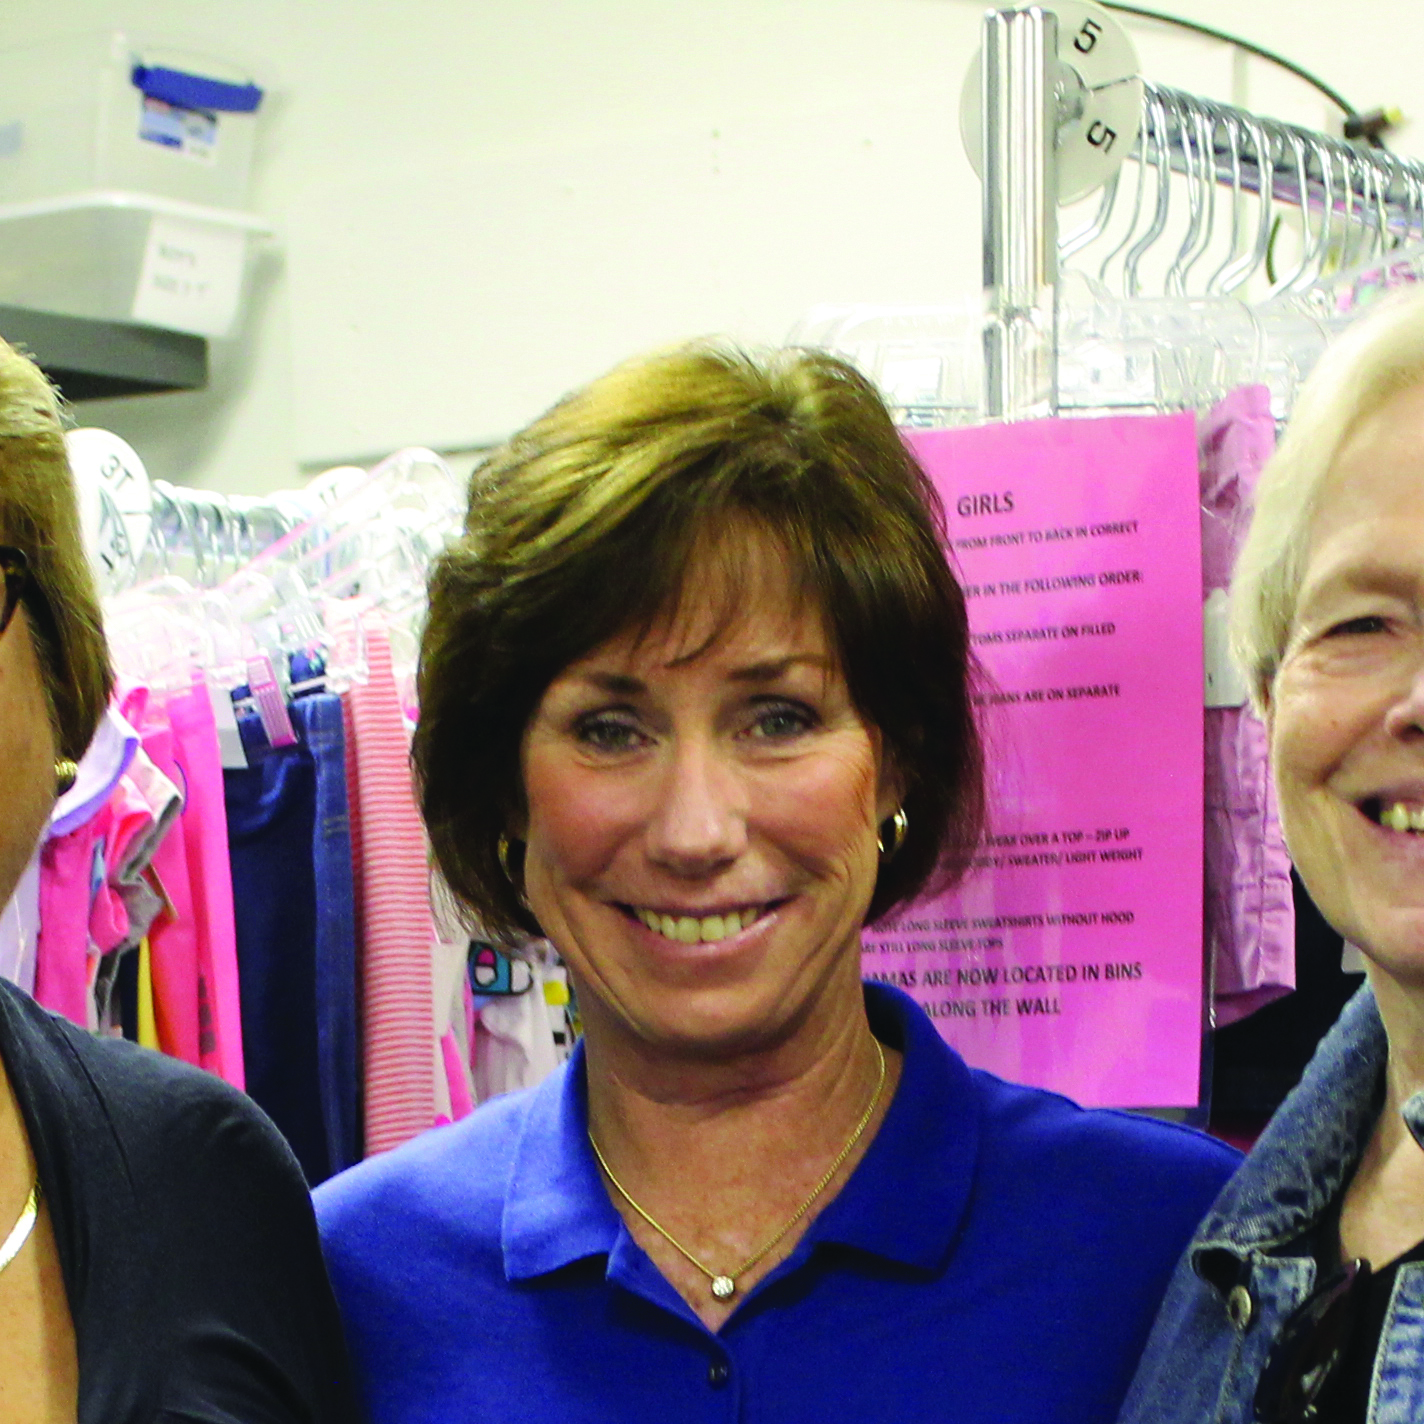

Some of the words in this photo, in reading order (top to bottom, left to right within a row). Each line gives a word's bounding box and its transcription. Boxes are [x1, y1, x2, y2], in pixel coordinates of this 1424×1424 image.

[1073, 17, 1103, 54] 5
[1085, 120, 1117, 155] 5
[100, 453, 134, 489] 3T
[957, 490, 1015, 516] GIRLS
[990, 532, 1025, 547] FRONT
[1029, 530, 1042, 543] TO
[1045, 526, 1073, 541] BACK
[1076, 525, 1088, 537] IN
[1090, 520, 1139, 536] CORRECT
[983, 582, 996, 595] IN
[1000, 579, 1021, 595] THE
[1025, 573, 1095, 593] FOLLOWING
[1098, 569, 1143, 586] ORDER:
[1005, 626, 1058, 643] SEPARATE
[1061, 625, 1079, 639] ON
[1081, 621, 1116, 636] FILLED
[1023, 689, 1045, 703] ARE
[1047, 687, 1064, 701] ON
[1066, 683, 1120, 698] SEPARATE
[1020, 832, 1049, 846] OVER
[1051, 831, 1060, 844] A
[1062, 829, 1084, 844] TOP
[1096, 828, 1113, 843] ZIP
[1115, 826, 1131, 841] UP
[1065, 850, 1096, 864] LIGHT
[1100, 847, 1143, 863] WEIGHT
[1046, 911, 1098, 926] WITHOUT
[1101, 910, 1135, 925] HOOD
[922, 967, 952, 987] ARE
[957, 965, 999, 986] NOW
[1003, 962, 1077, 985] LOCATED
[1082, 963, 1100, 981] IN
[1105, 961, 1143, 982] BINS
[925, 999, 976, 1020] ALONG
[981, 998, 1010, 1017] THE
[1016, 996, 1062, 1016] WALL
